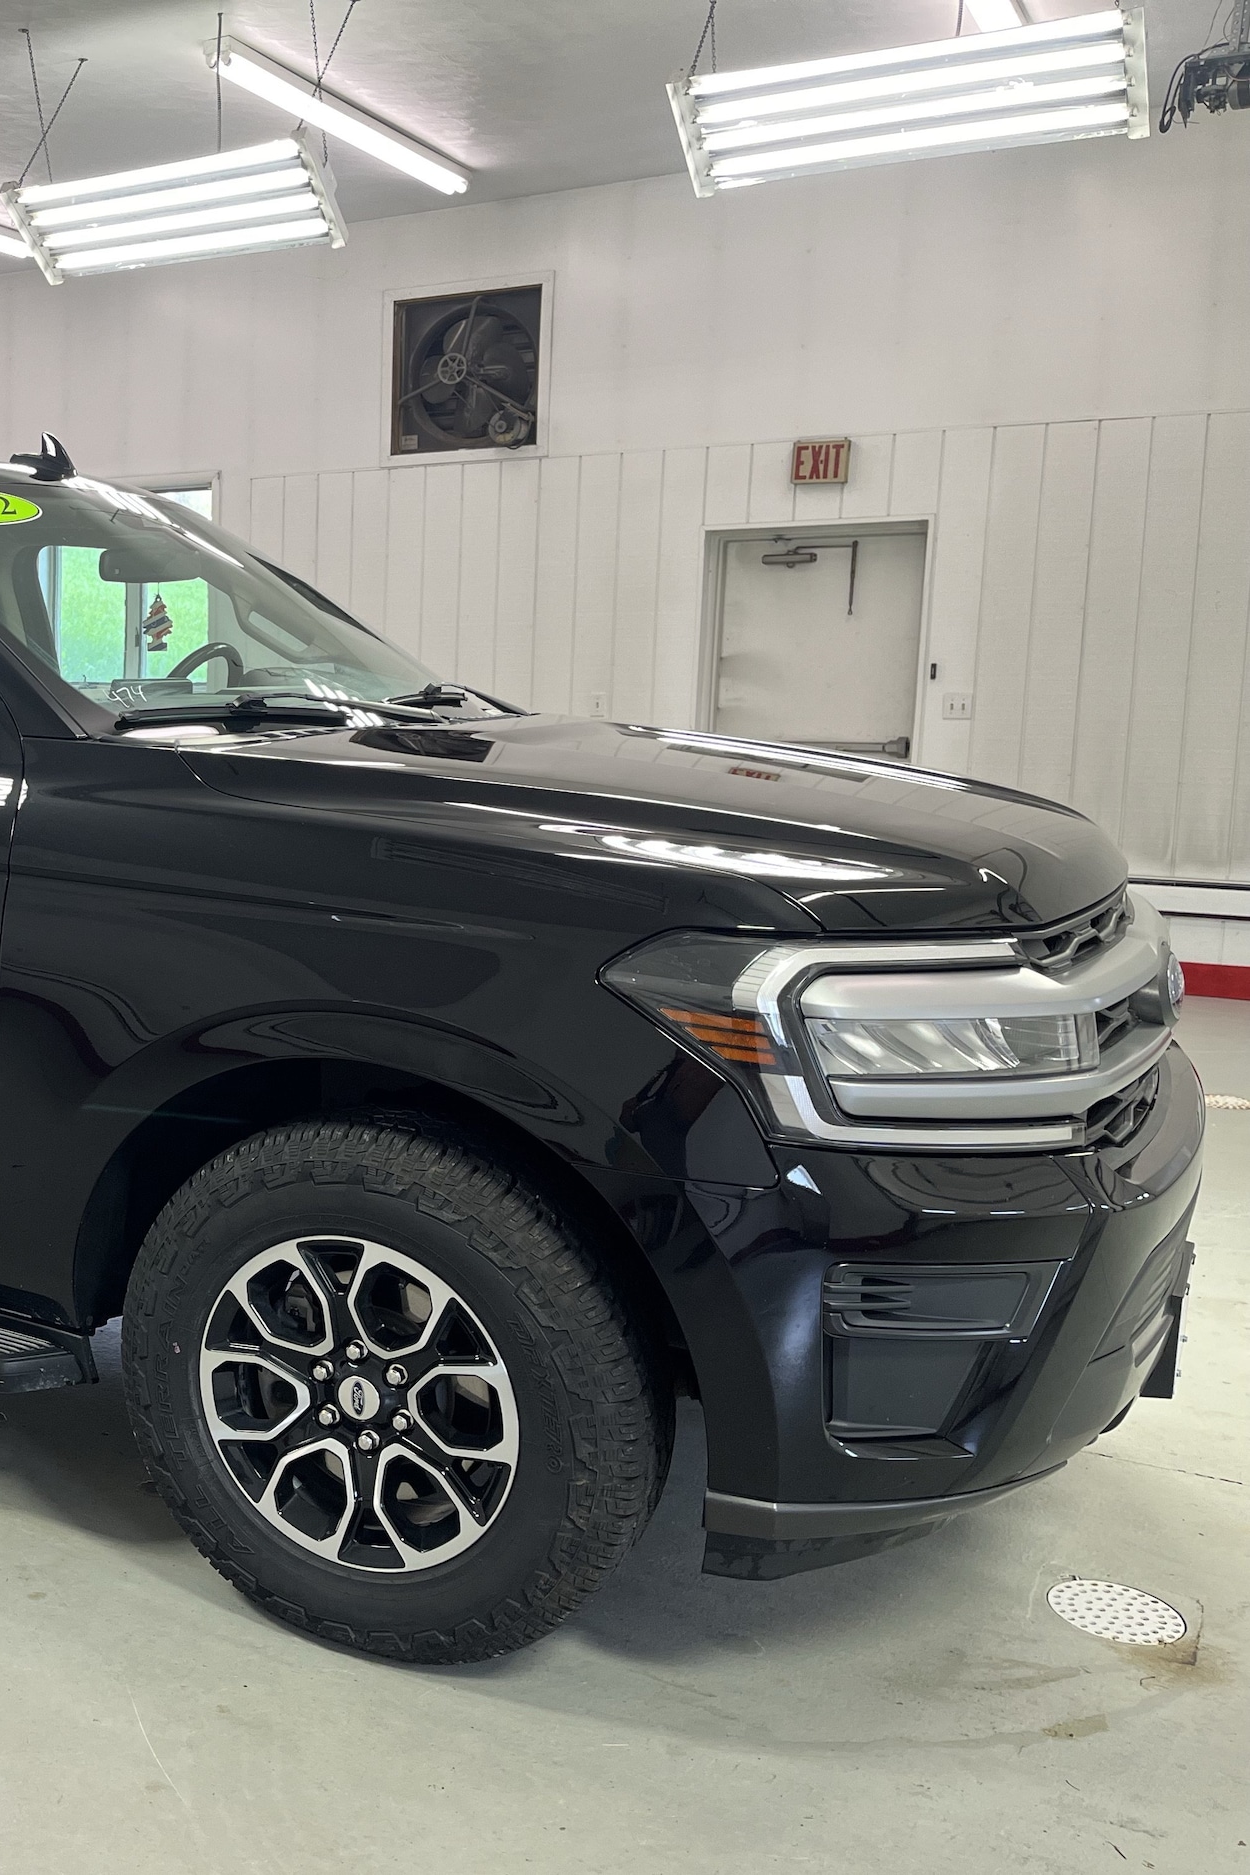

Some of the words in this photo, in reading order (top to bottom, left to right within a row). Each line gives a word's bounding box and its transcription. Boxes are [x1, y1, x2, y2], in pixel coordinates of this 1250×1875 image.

[794, 444, 845, 480] EXIT
[102, 685, 147, 708] 474
[352, 1385, 365, 1412] Ford
